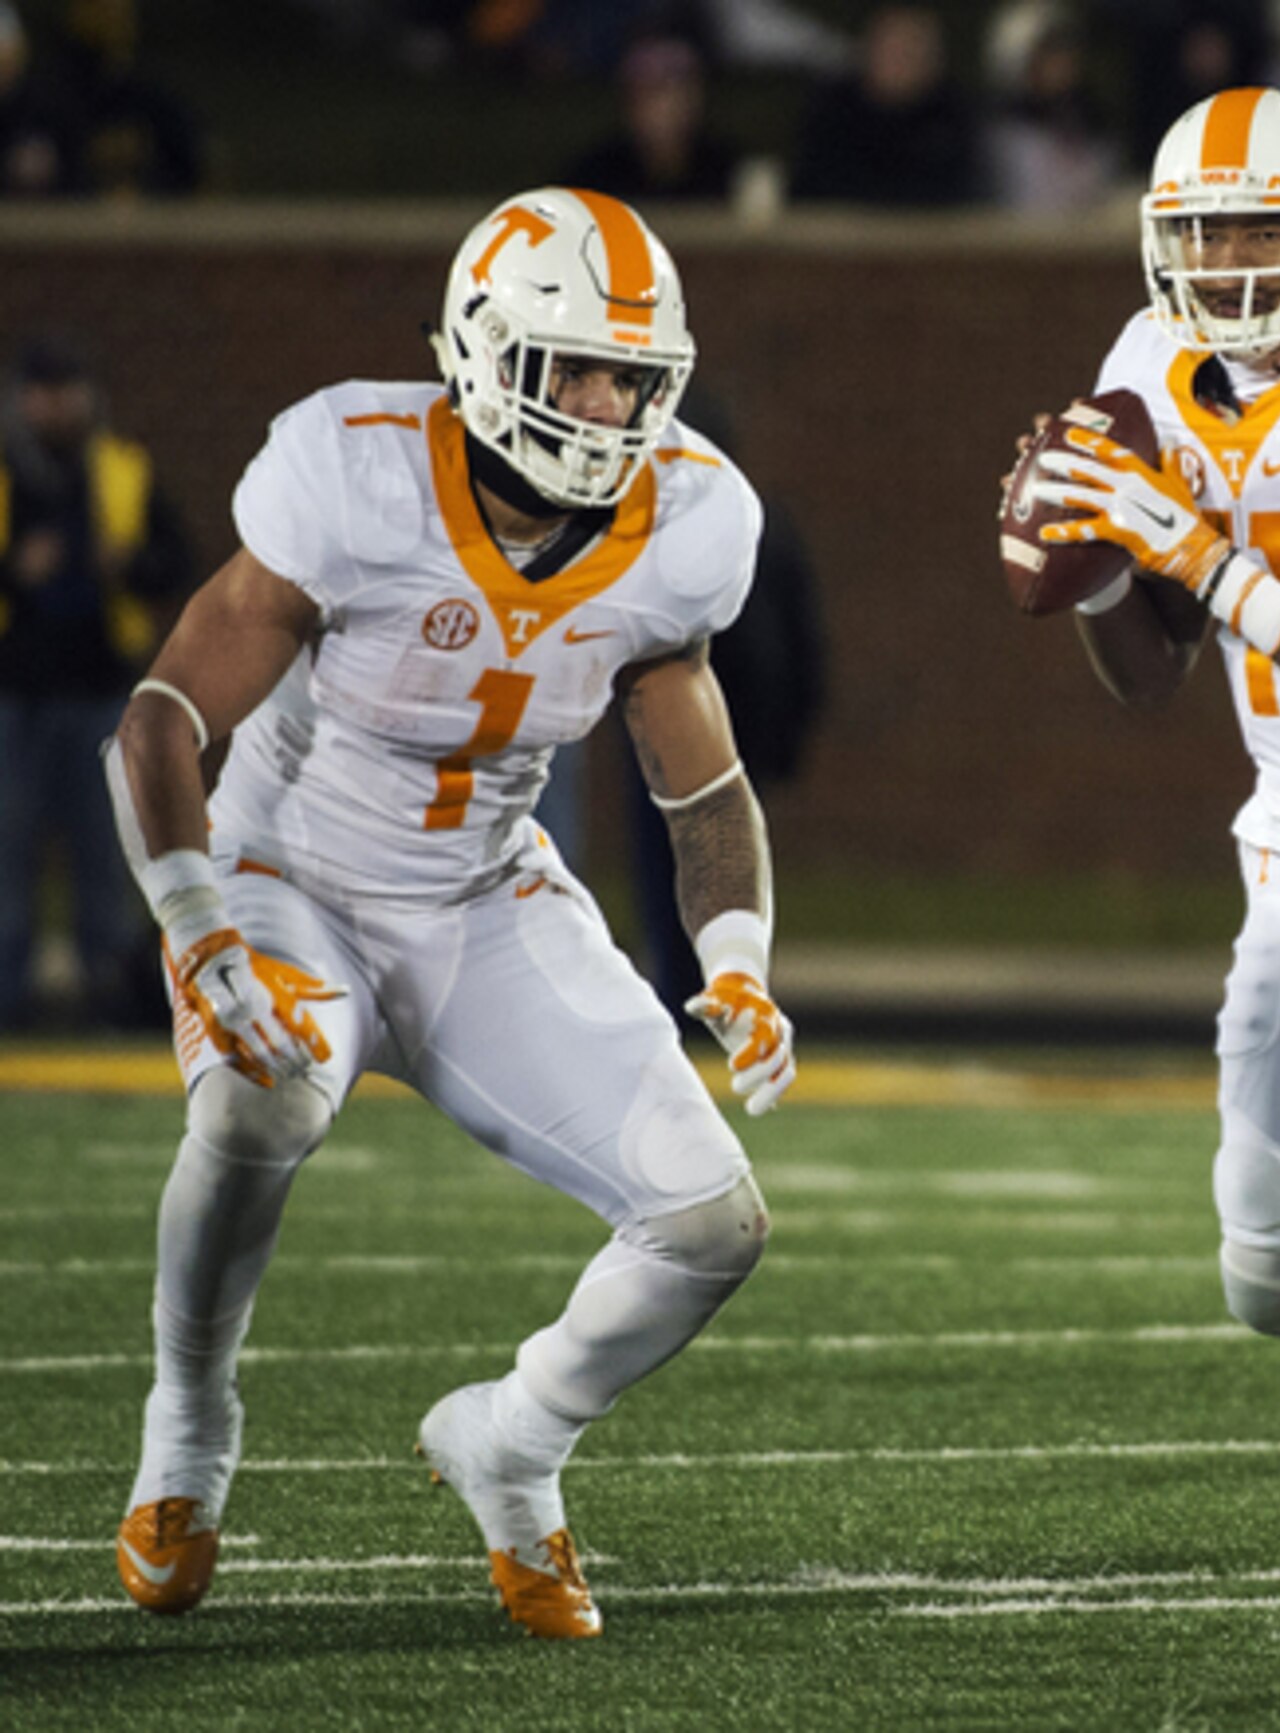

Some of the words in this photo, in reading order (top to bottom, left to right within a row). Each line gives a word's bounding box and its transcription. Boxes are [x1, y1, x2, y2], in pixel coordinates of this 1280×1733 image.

[470, 206, 556, 286] T
[1221, 449, 1245, 482] T
[424, 602, 478, 650] SEC
[508, 609, 541, 643] T
[423, 667, 538, 832] 1
